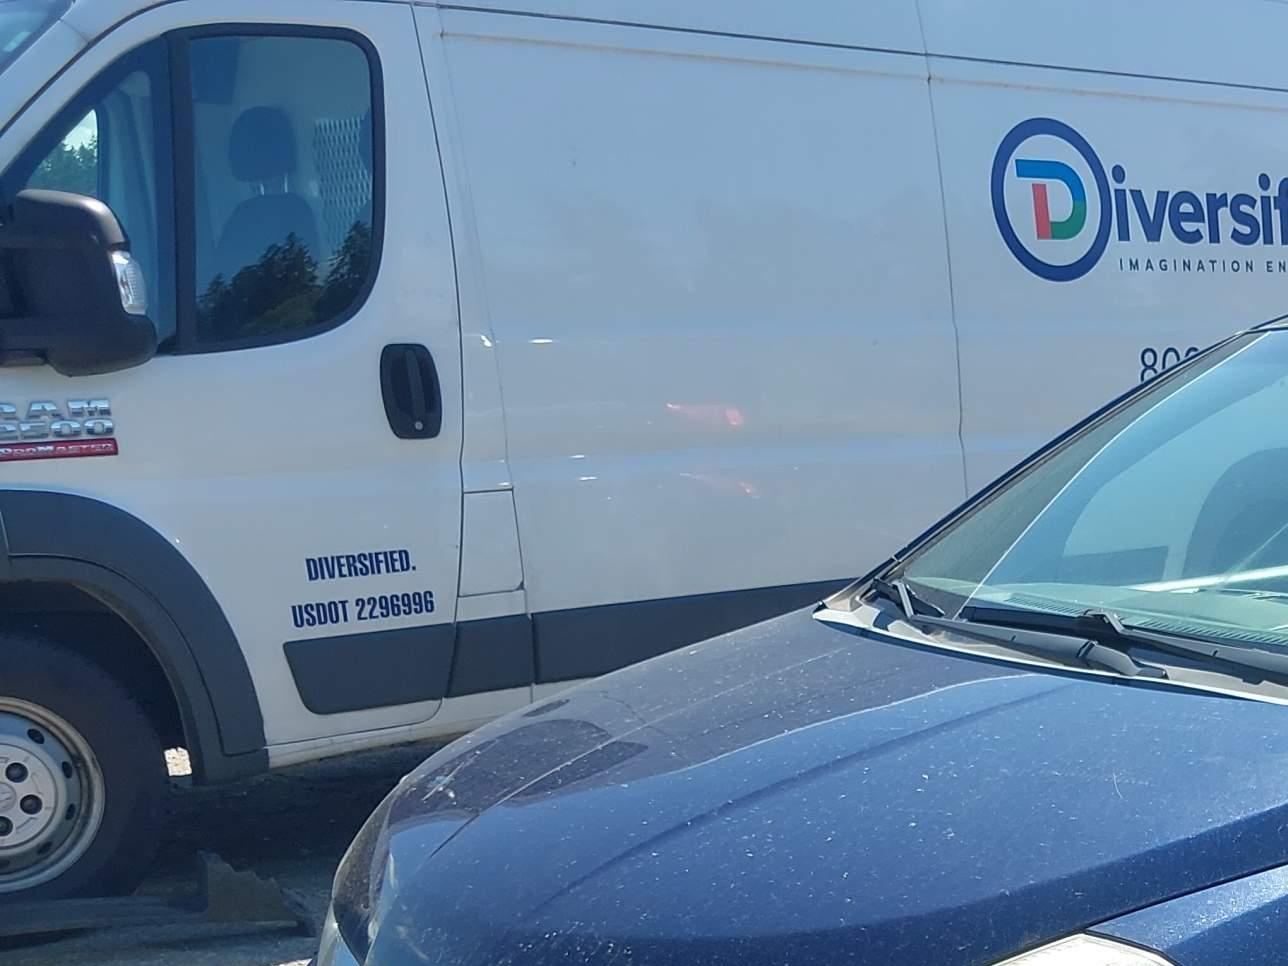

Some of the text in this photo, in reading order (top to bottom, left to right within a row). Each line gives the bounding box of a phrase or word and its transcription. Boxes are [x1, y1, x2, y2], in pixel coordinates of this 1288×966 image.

[1119, 258, 1255, 273] IMAGINATION
[304, 549, 417, 581] DIVERSIFIED.
[290, 590, 435, 629] USDOT 2296996
